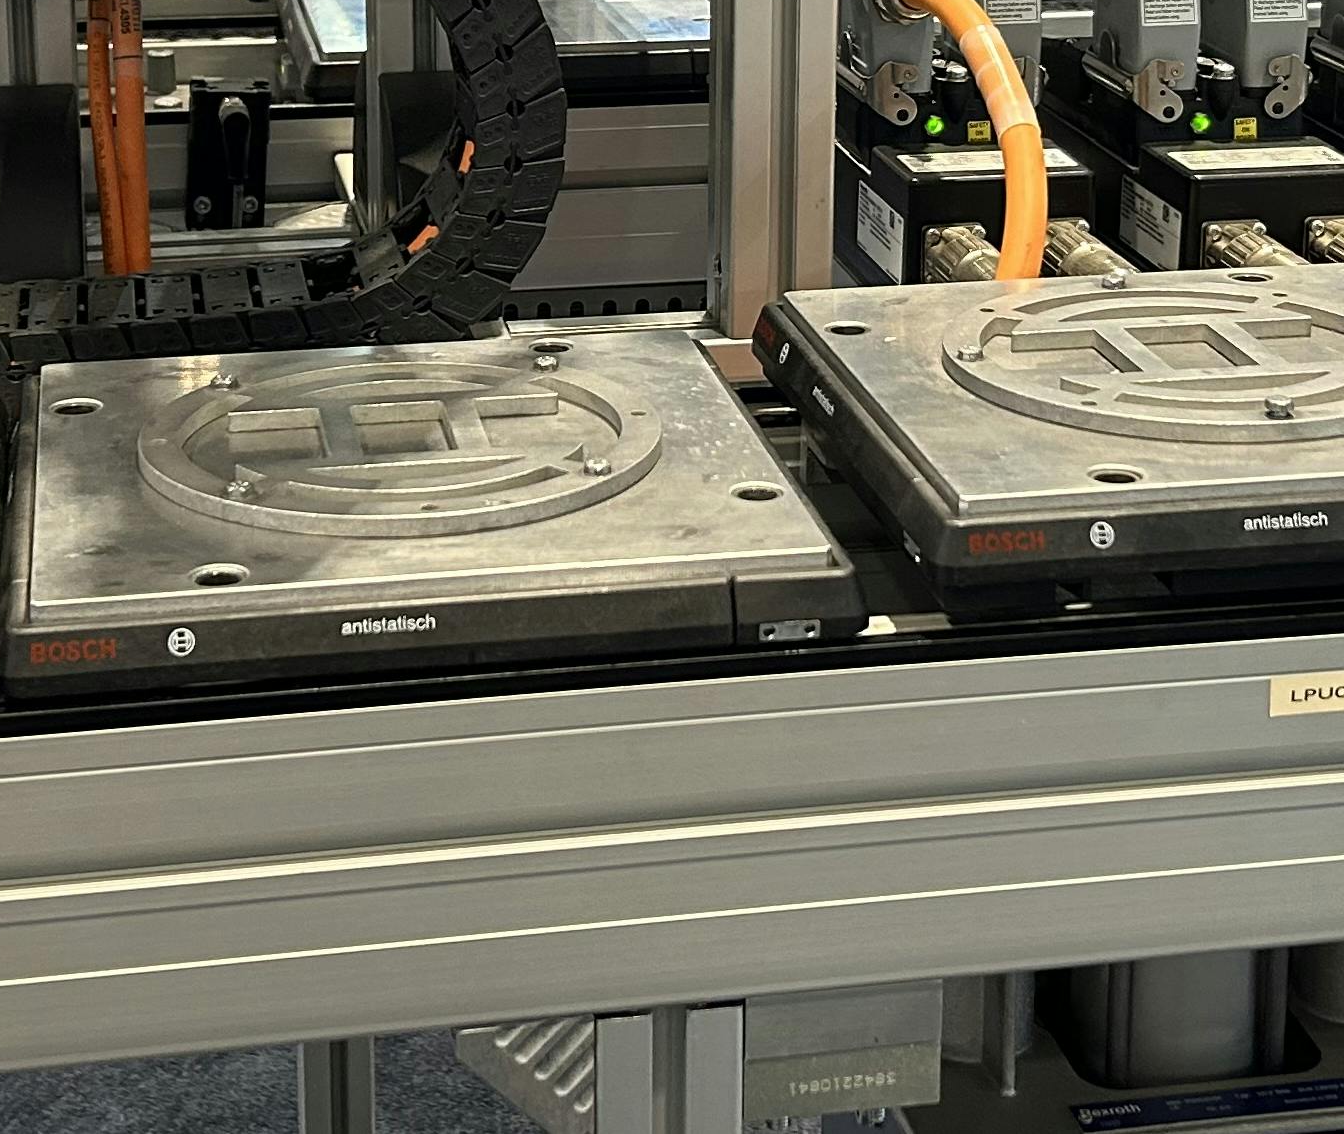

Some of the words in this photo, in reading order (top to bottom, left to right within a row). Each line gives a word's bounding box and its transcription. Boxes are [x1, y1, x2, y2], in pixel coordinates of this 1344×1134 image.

[968, 529, 1046, 555] BOSCH
[1243, 511, 1329, 532] antistatisch
[30, 639, 117, 664] BOSCH
[341, 613, 437, 635] antistatisch
